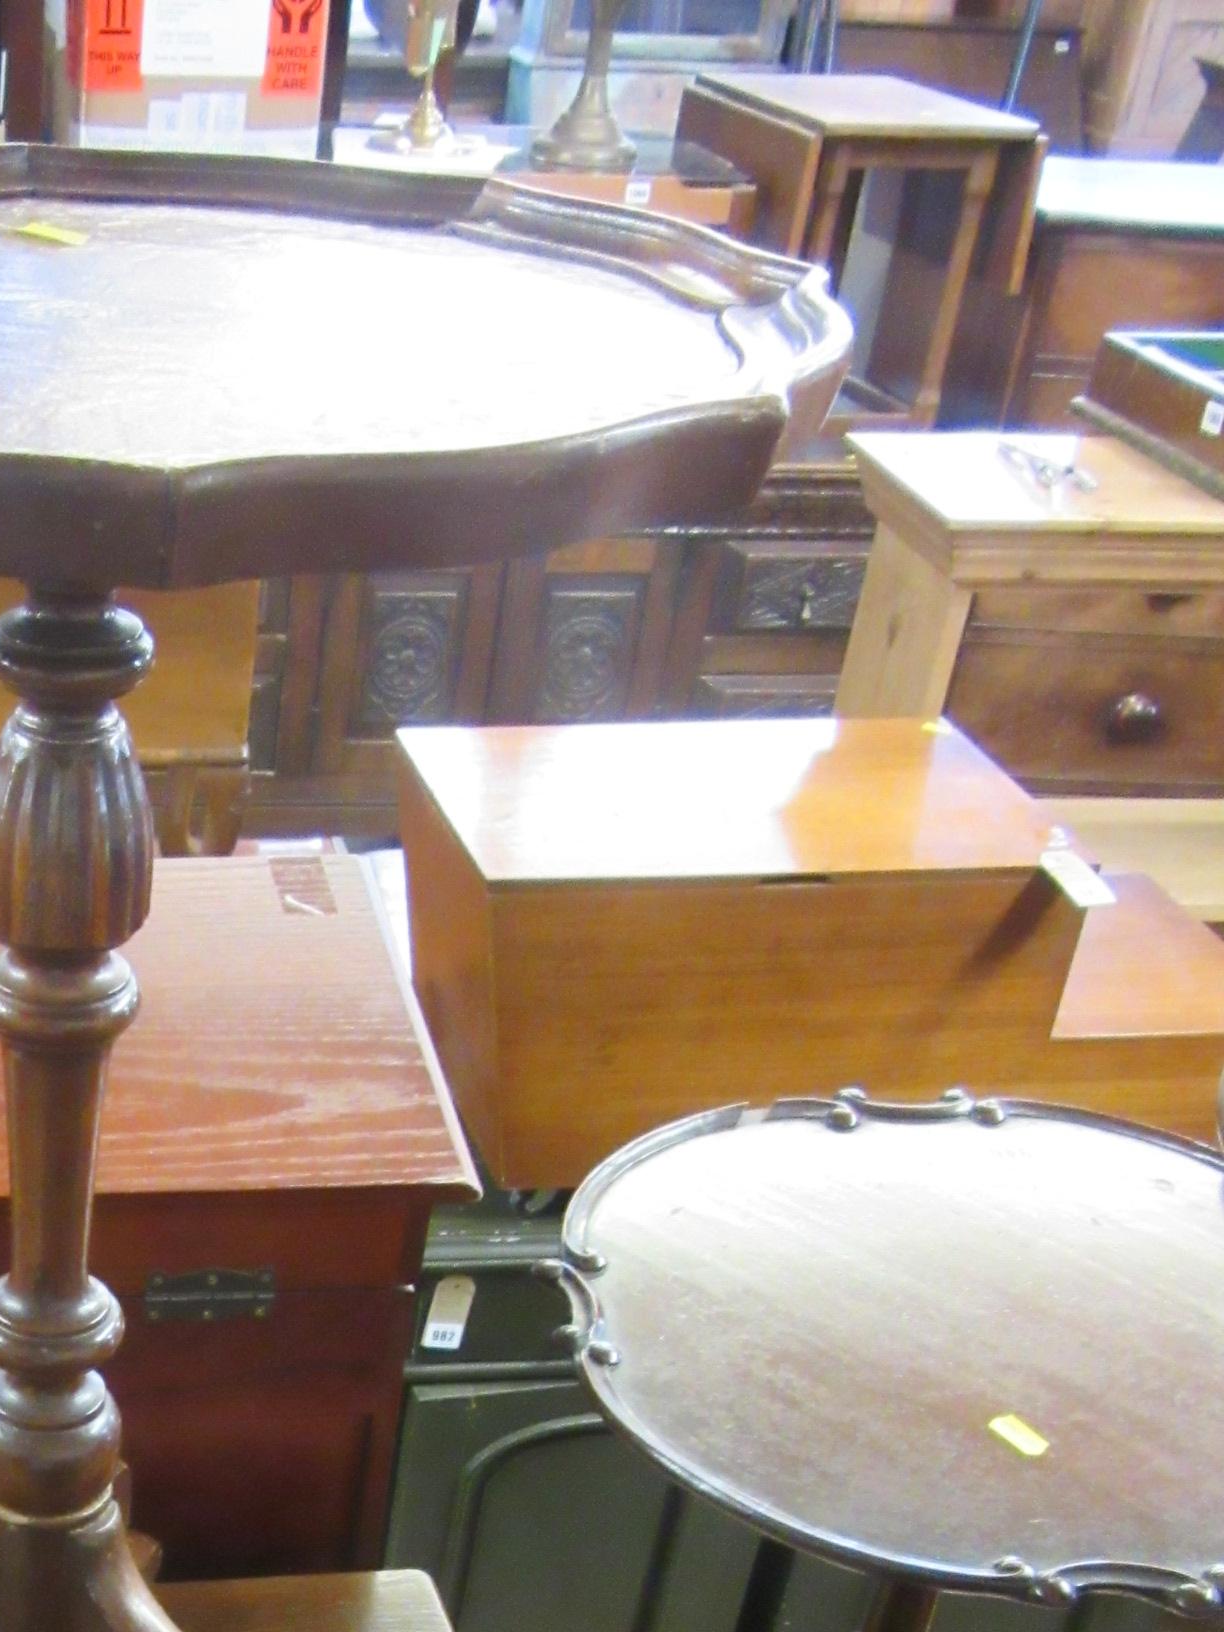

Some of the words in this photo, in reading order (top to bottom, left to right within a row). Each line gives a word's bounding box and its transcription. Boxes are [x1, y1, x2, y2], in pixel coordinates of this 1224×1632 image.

[88, 51, 114, 62] THIS
[117, 51, 141, 62] WAY
[267, 47, 318, 58] HANDLE
[106, 64, 123, 75] UP
[275, 62, 307, 73] WITH
[272, 78, 307, 89] CARE
